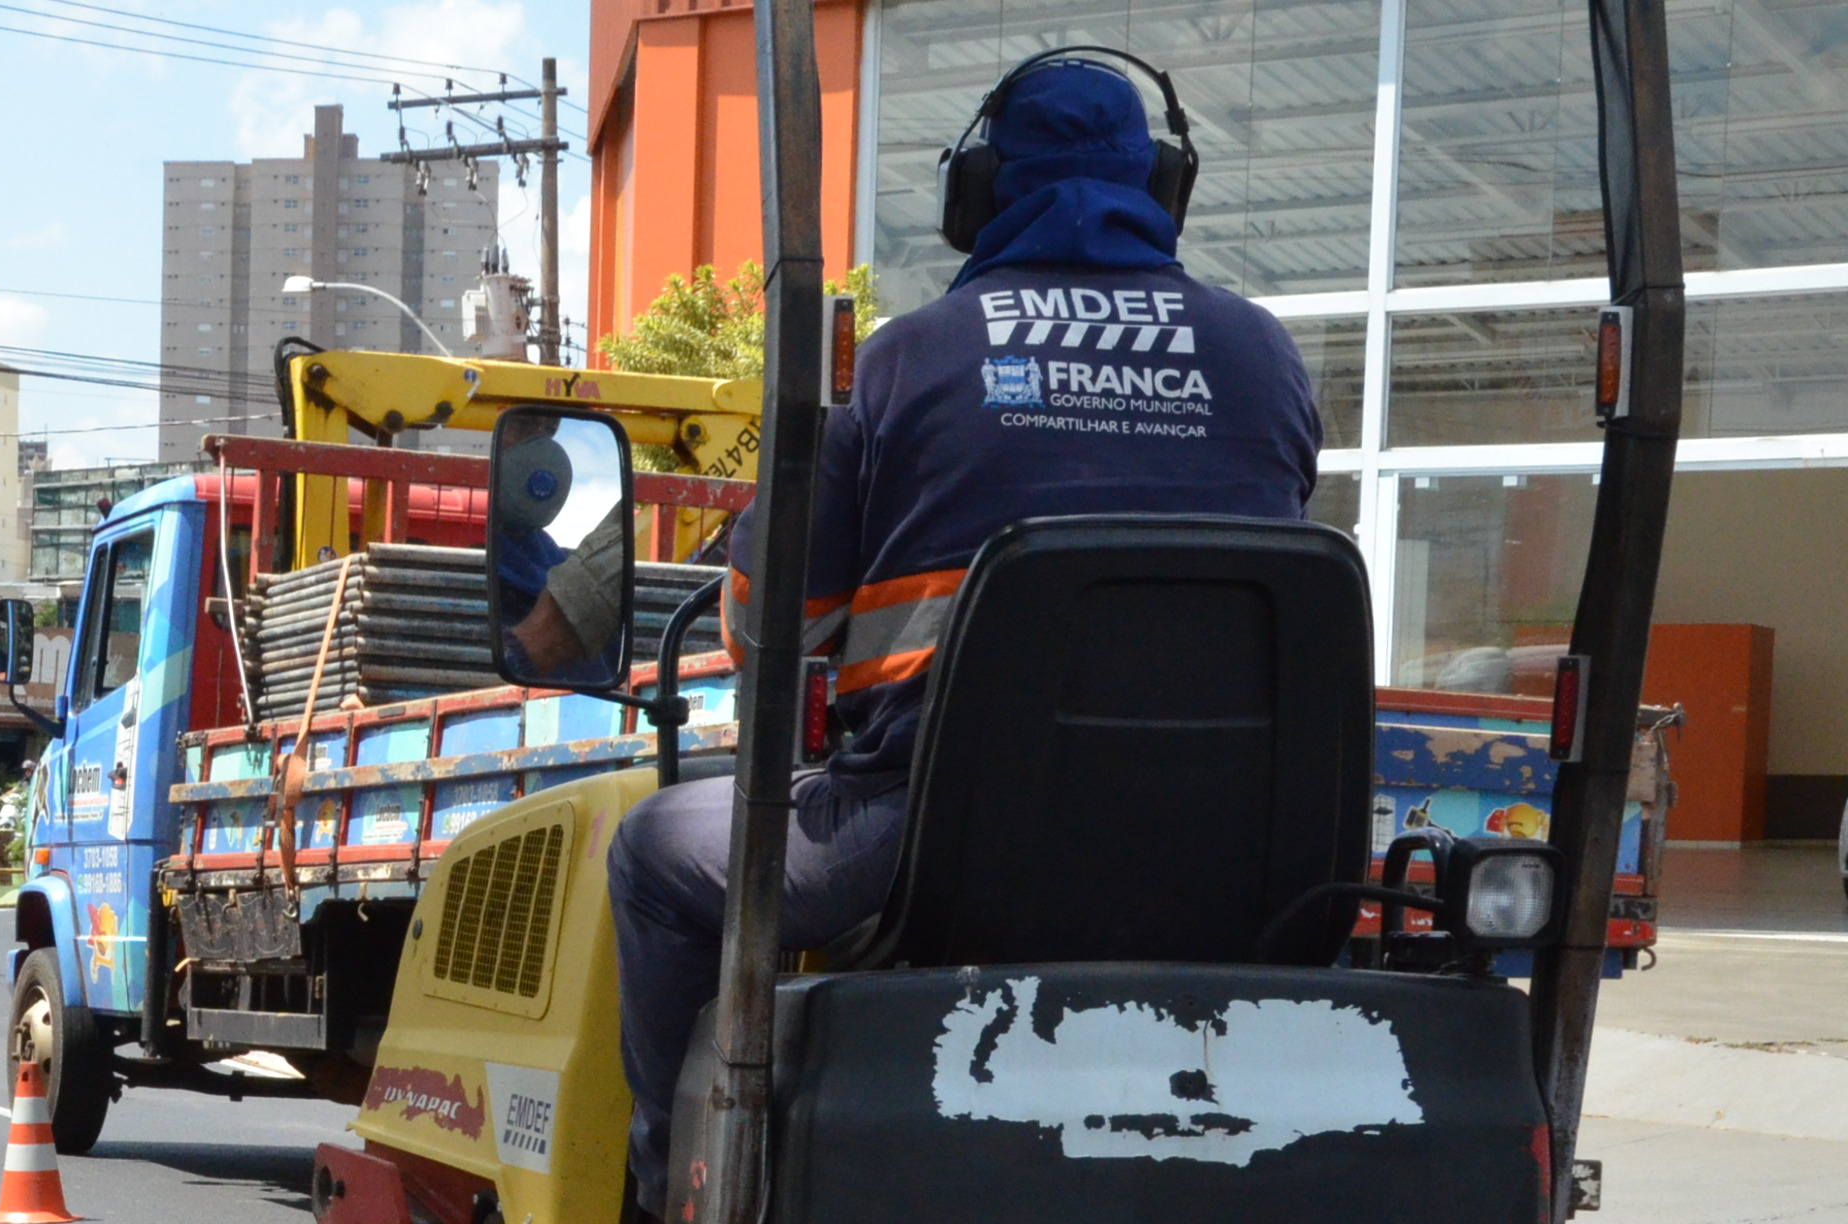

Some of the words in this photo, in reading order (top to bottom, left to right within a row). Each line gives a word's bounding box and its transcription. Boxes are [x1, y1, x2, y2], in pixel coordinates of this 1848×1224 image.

[980, 288, 1185, 323] EMDEF
[545, 372, 601, 399] HYVA
[1048, 361, 1213, 400] FRANCA
[1050, 393, 1126, 411] GOVERNO
[1130, 399, 1213, 416] MUNICIPAL
[1000, 413, 1119, 433] COMPARTILHAR
[1122, 421, 1131, 434] E
[1135, 422, 1207, 439] AVANÇAR
[506, 1093, 551, 1134] EMDEF
